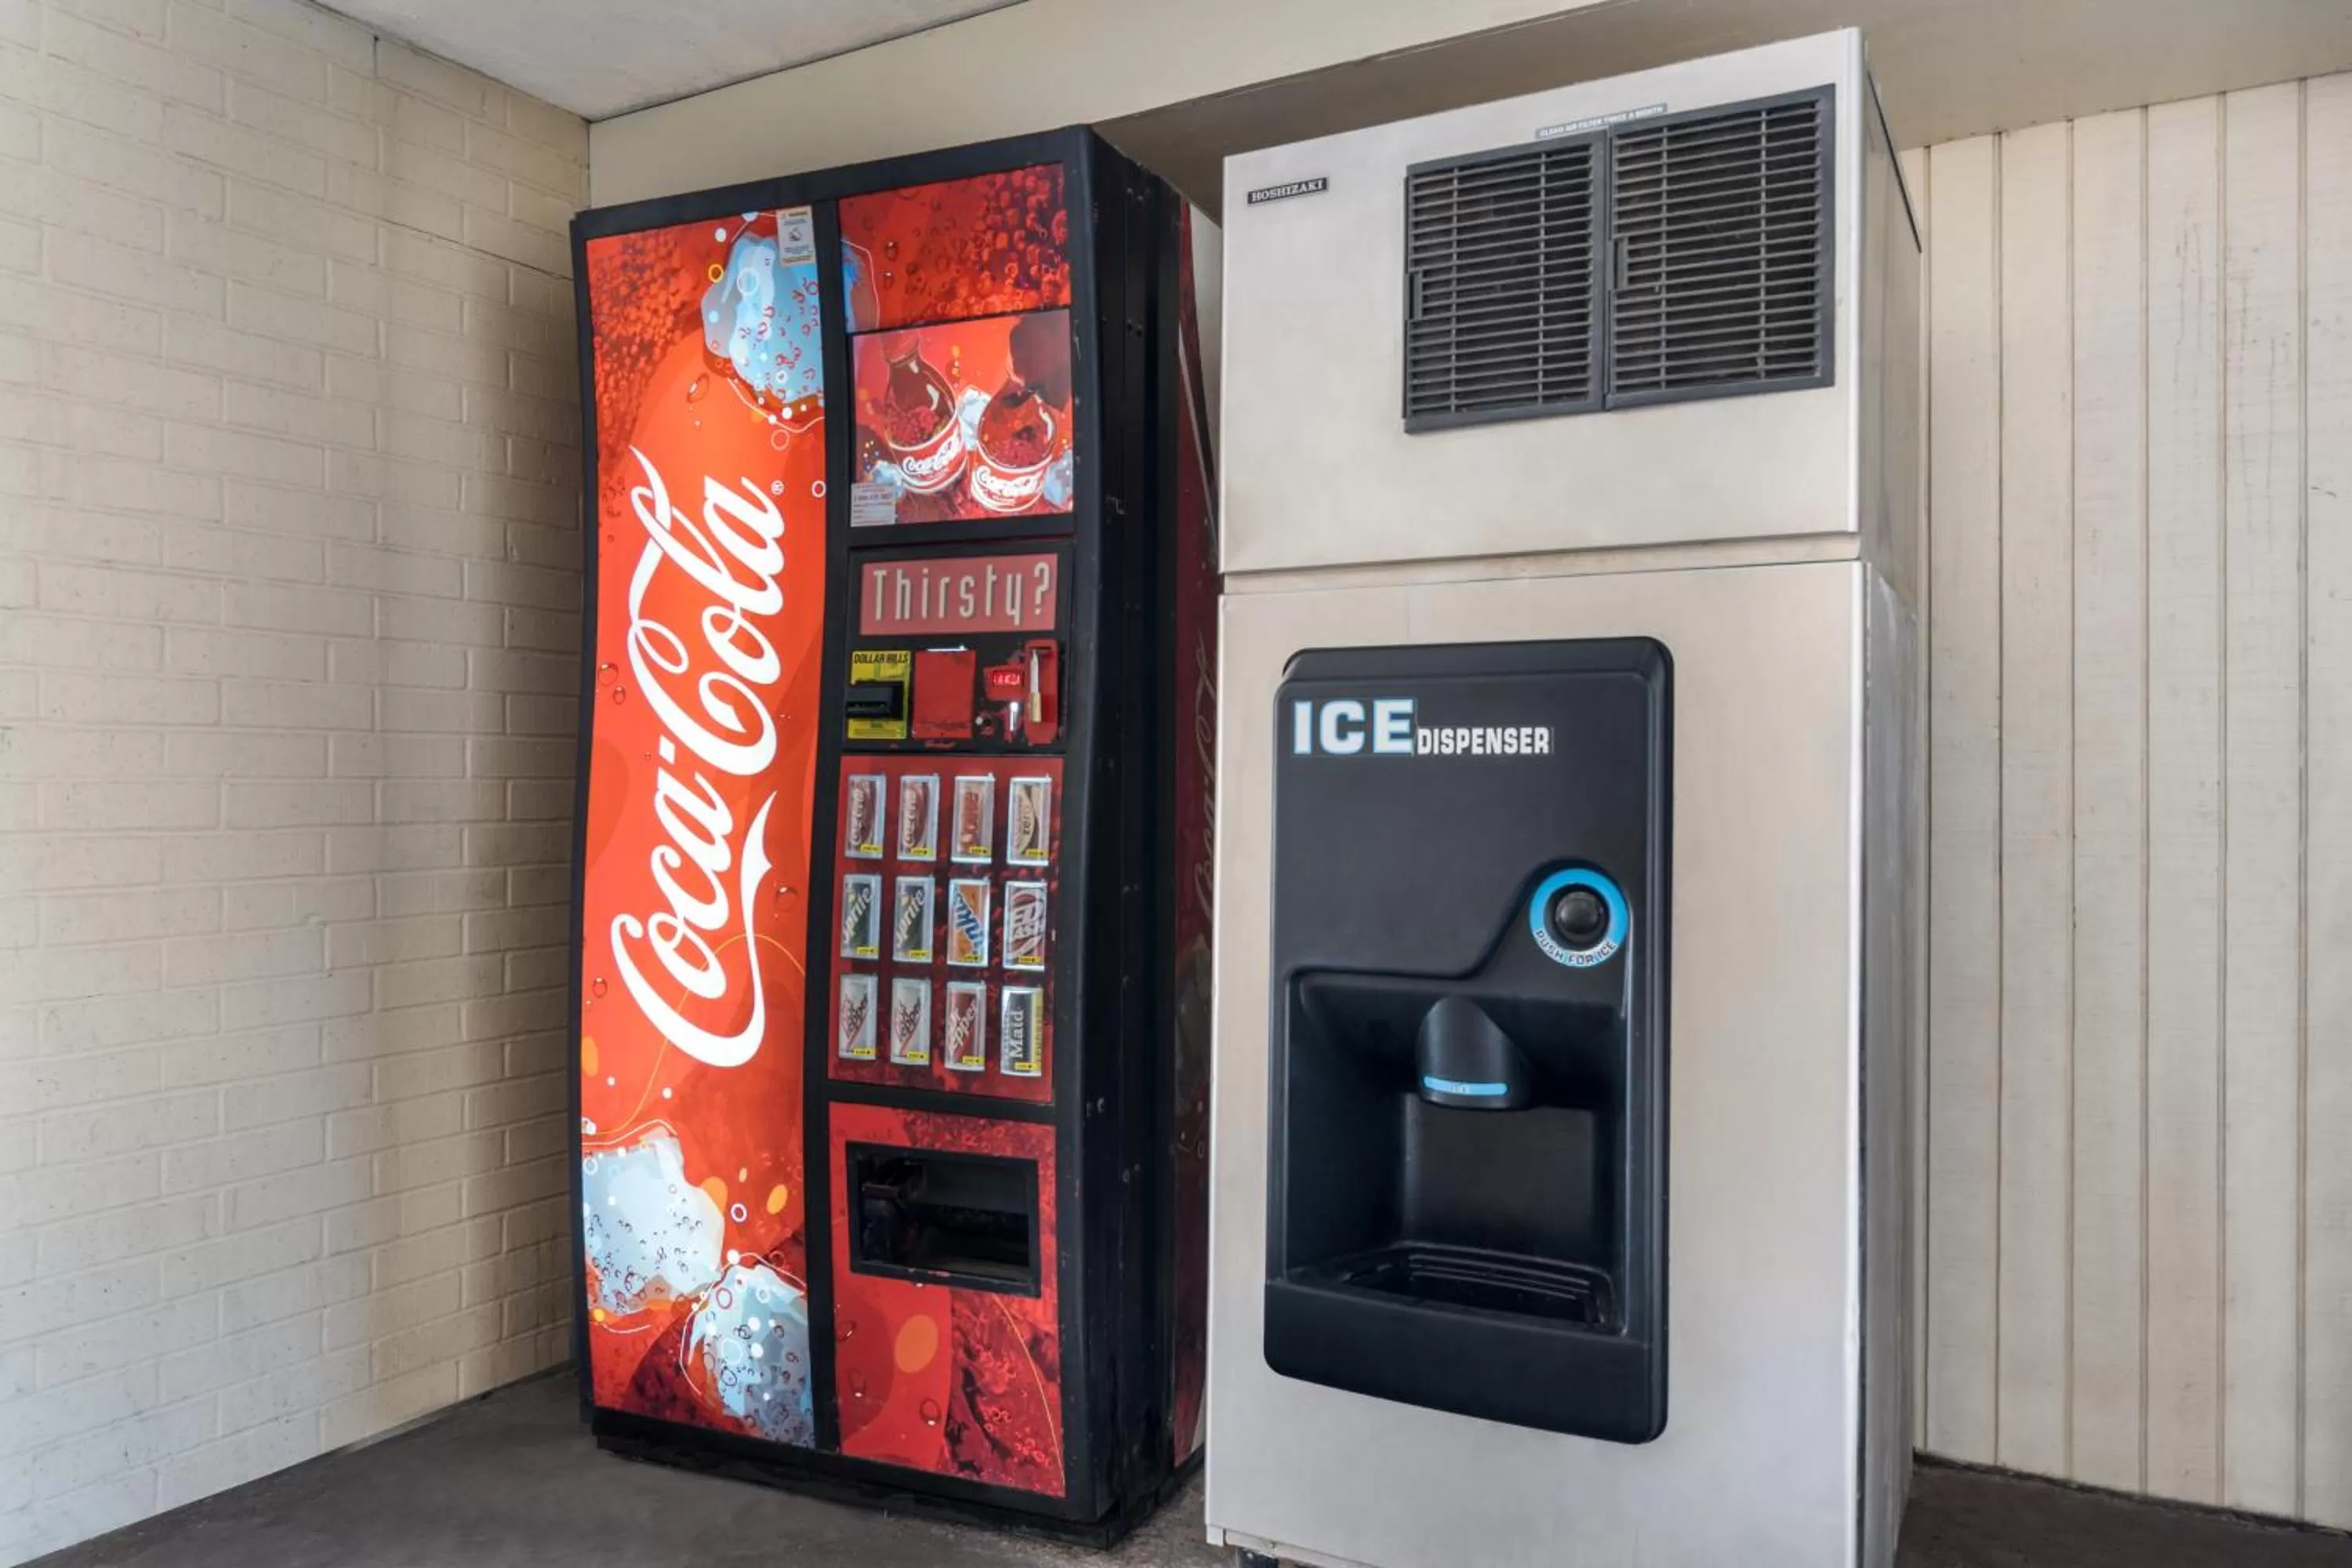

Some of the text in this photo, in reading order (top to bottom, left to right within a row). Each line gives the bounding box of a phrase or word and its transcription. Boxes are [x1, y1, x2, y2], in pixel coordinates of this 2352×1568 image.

[1251, 180, 1323, 202] HOSHIZAKI
[873, 561, 1051, 626] Thirsty?
[854, 652, 884, 665] DOLLAR
[1294, 699, 1551, 756] ICE DISPENSER
[610, 445, 785, 1068] Coca-Cola
[1536, 929, 1566, 962] PUSH
[1568, 953, 1594, 965] FOR
[1009, 1009, 1024, 1058] Maid
